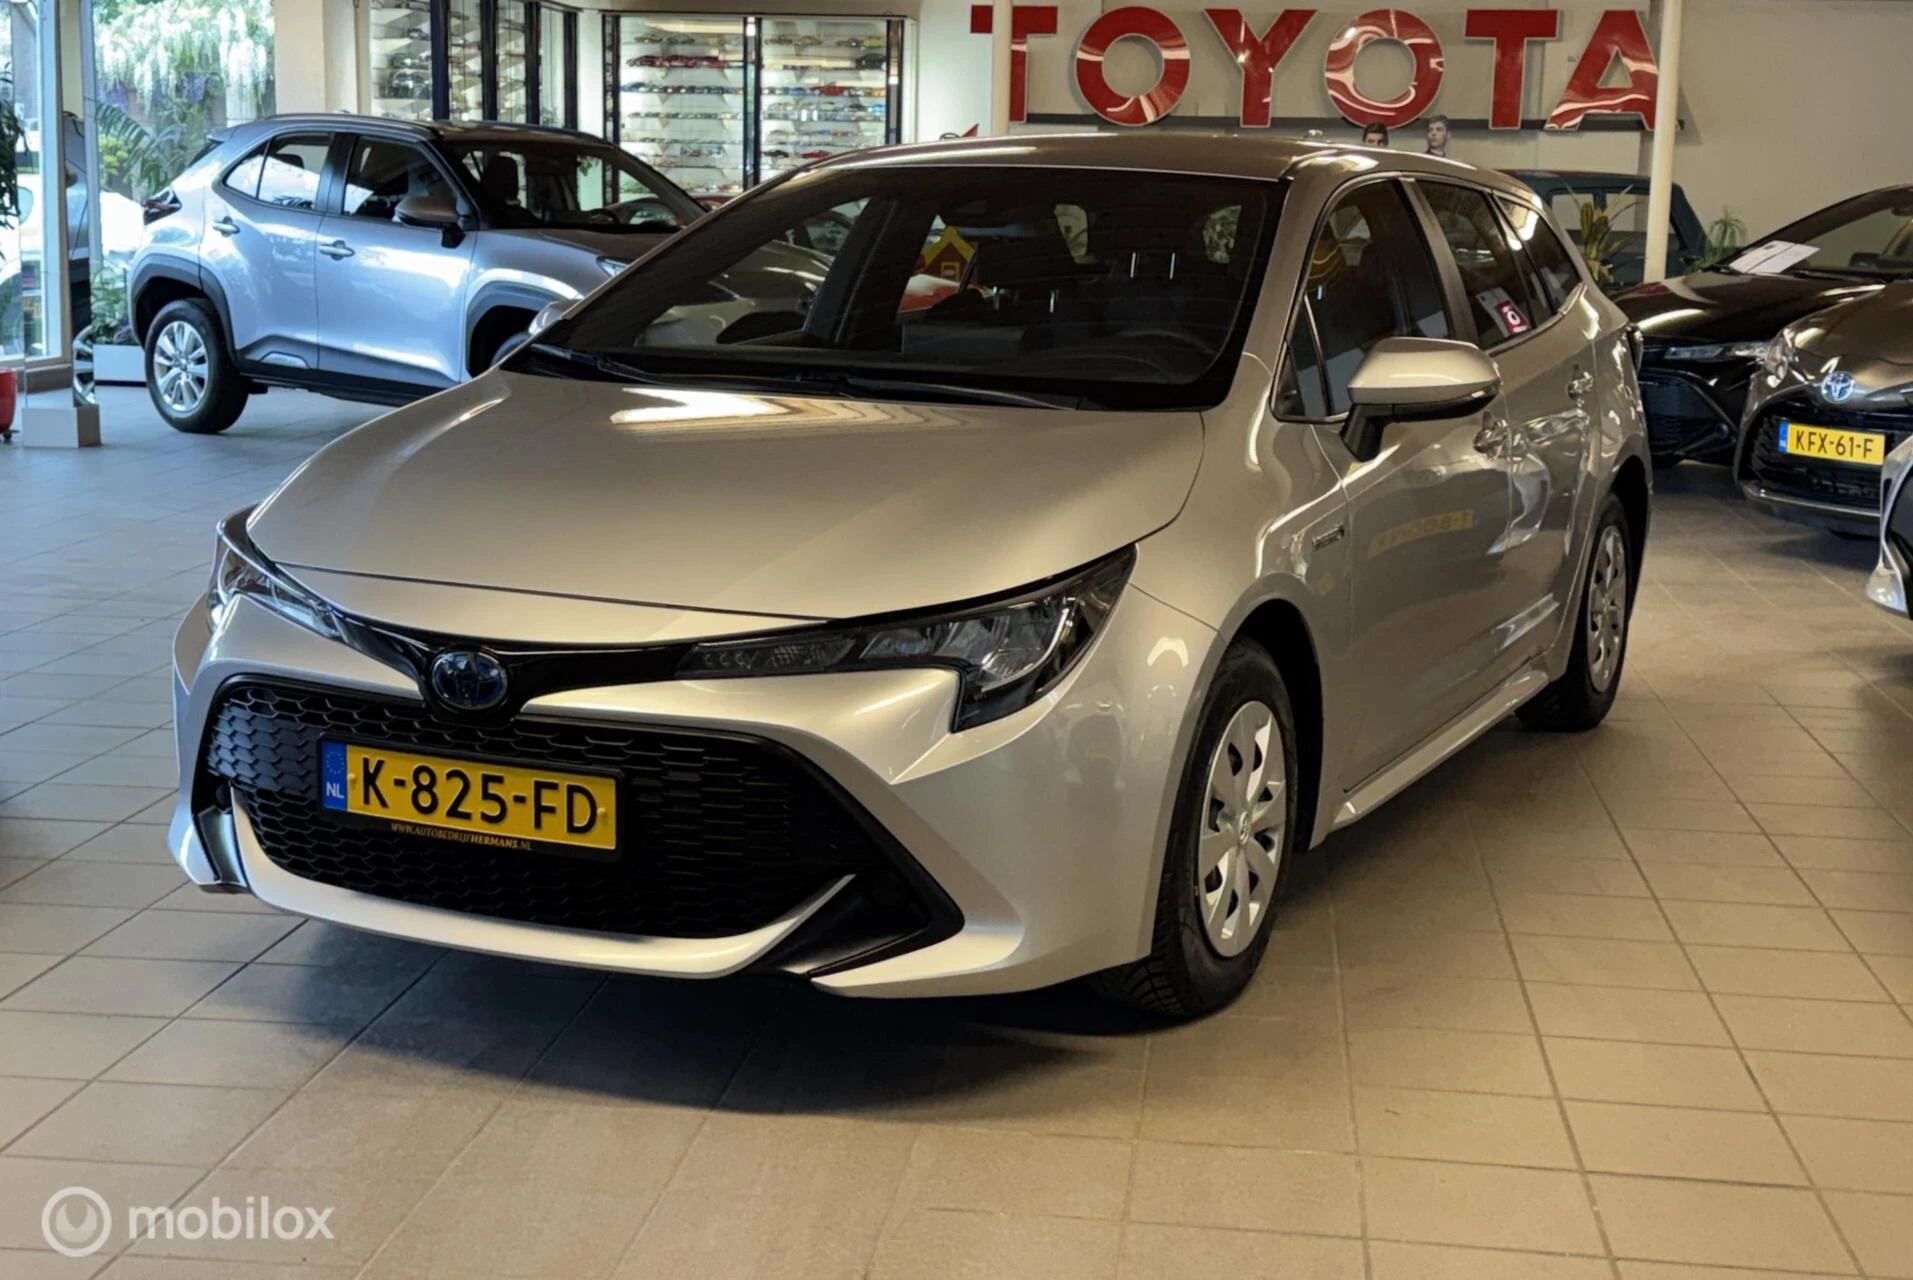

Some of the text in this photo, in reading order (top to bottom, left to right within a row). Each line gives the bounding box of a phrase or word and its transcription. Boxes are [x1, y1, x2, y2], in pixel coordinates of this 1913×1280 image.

[970, 6, 1670, 131] TOYOTA
[1795, 429, 1875, 459] KFX-61-F
[325, 781, 345, 800] NL
[361, 756, 598, 835] K-825-FD
